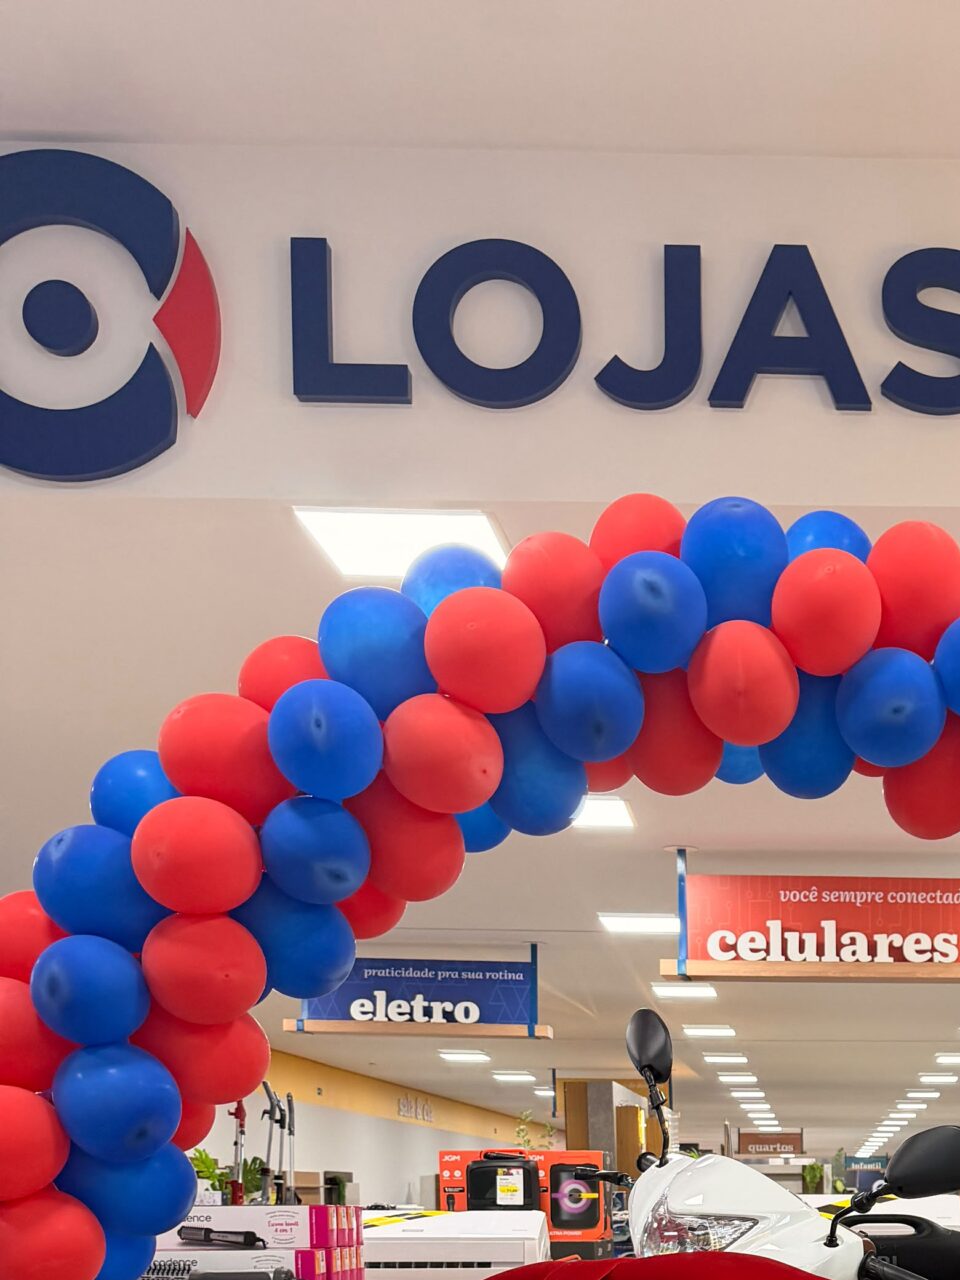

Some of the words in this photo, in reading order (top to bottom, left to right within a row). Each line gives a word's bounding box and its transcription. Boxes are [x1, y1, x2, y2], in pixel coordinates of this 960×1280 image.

[779, 886, 818, 903] você
[822, 889, 884, 906] sempre
[706, 919, 959, 963] celulares
[364, 968, 436, 979] praticidade
[437, 970, 459, 981] pra
[461, 971, 484, 980] sua
[485, 969, 525, 980] rotina
[350, 990, 480, 1024] eletro
[747, 1143, 794, 1154] quartos
[183, 1214, 212, 1223] ence
